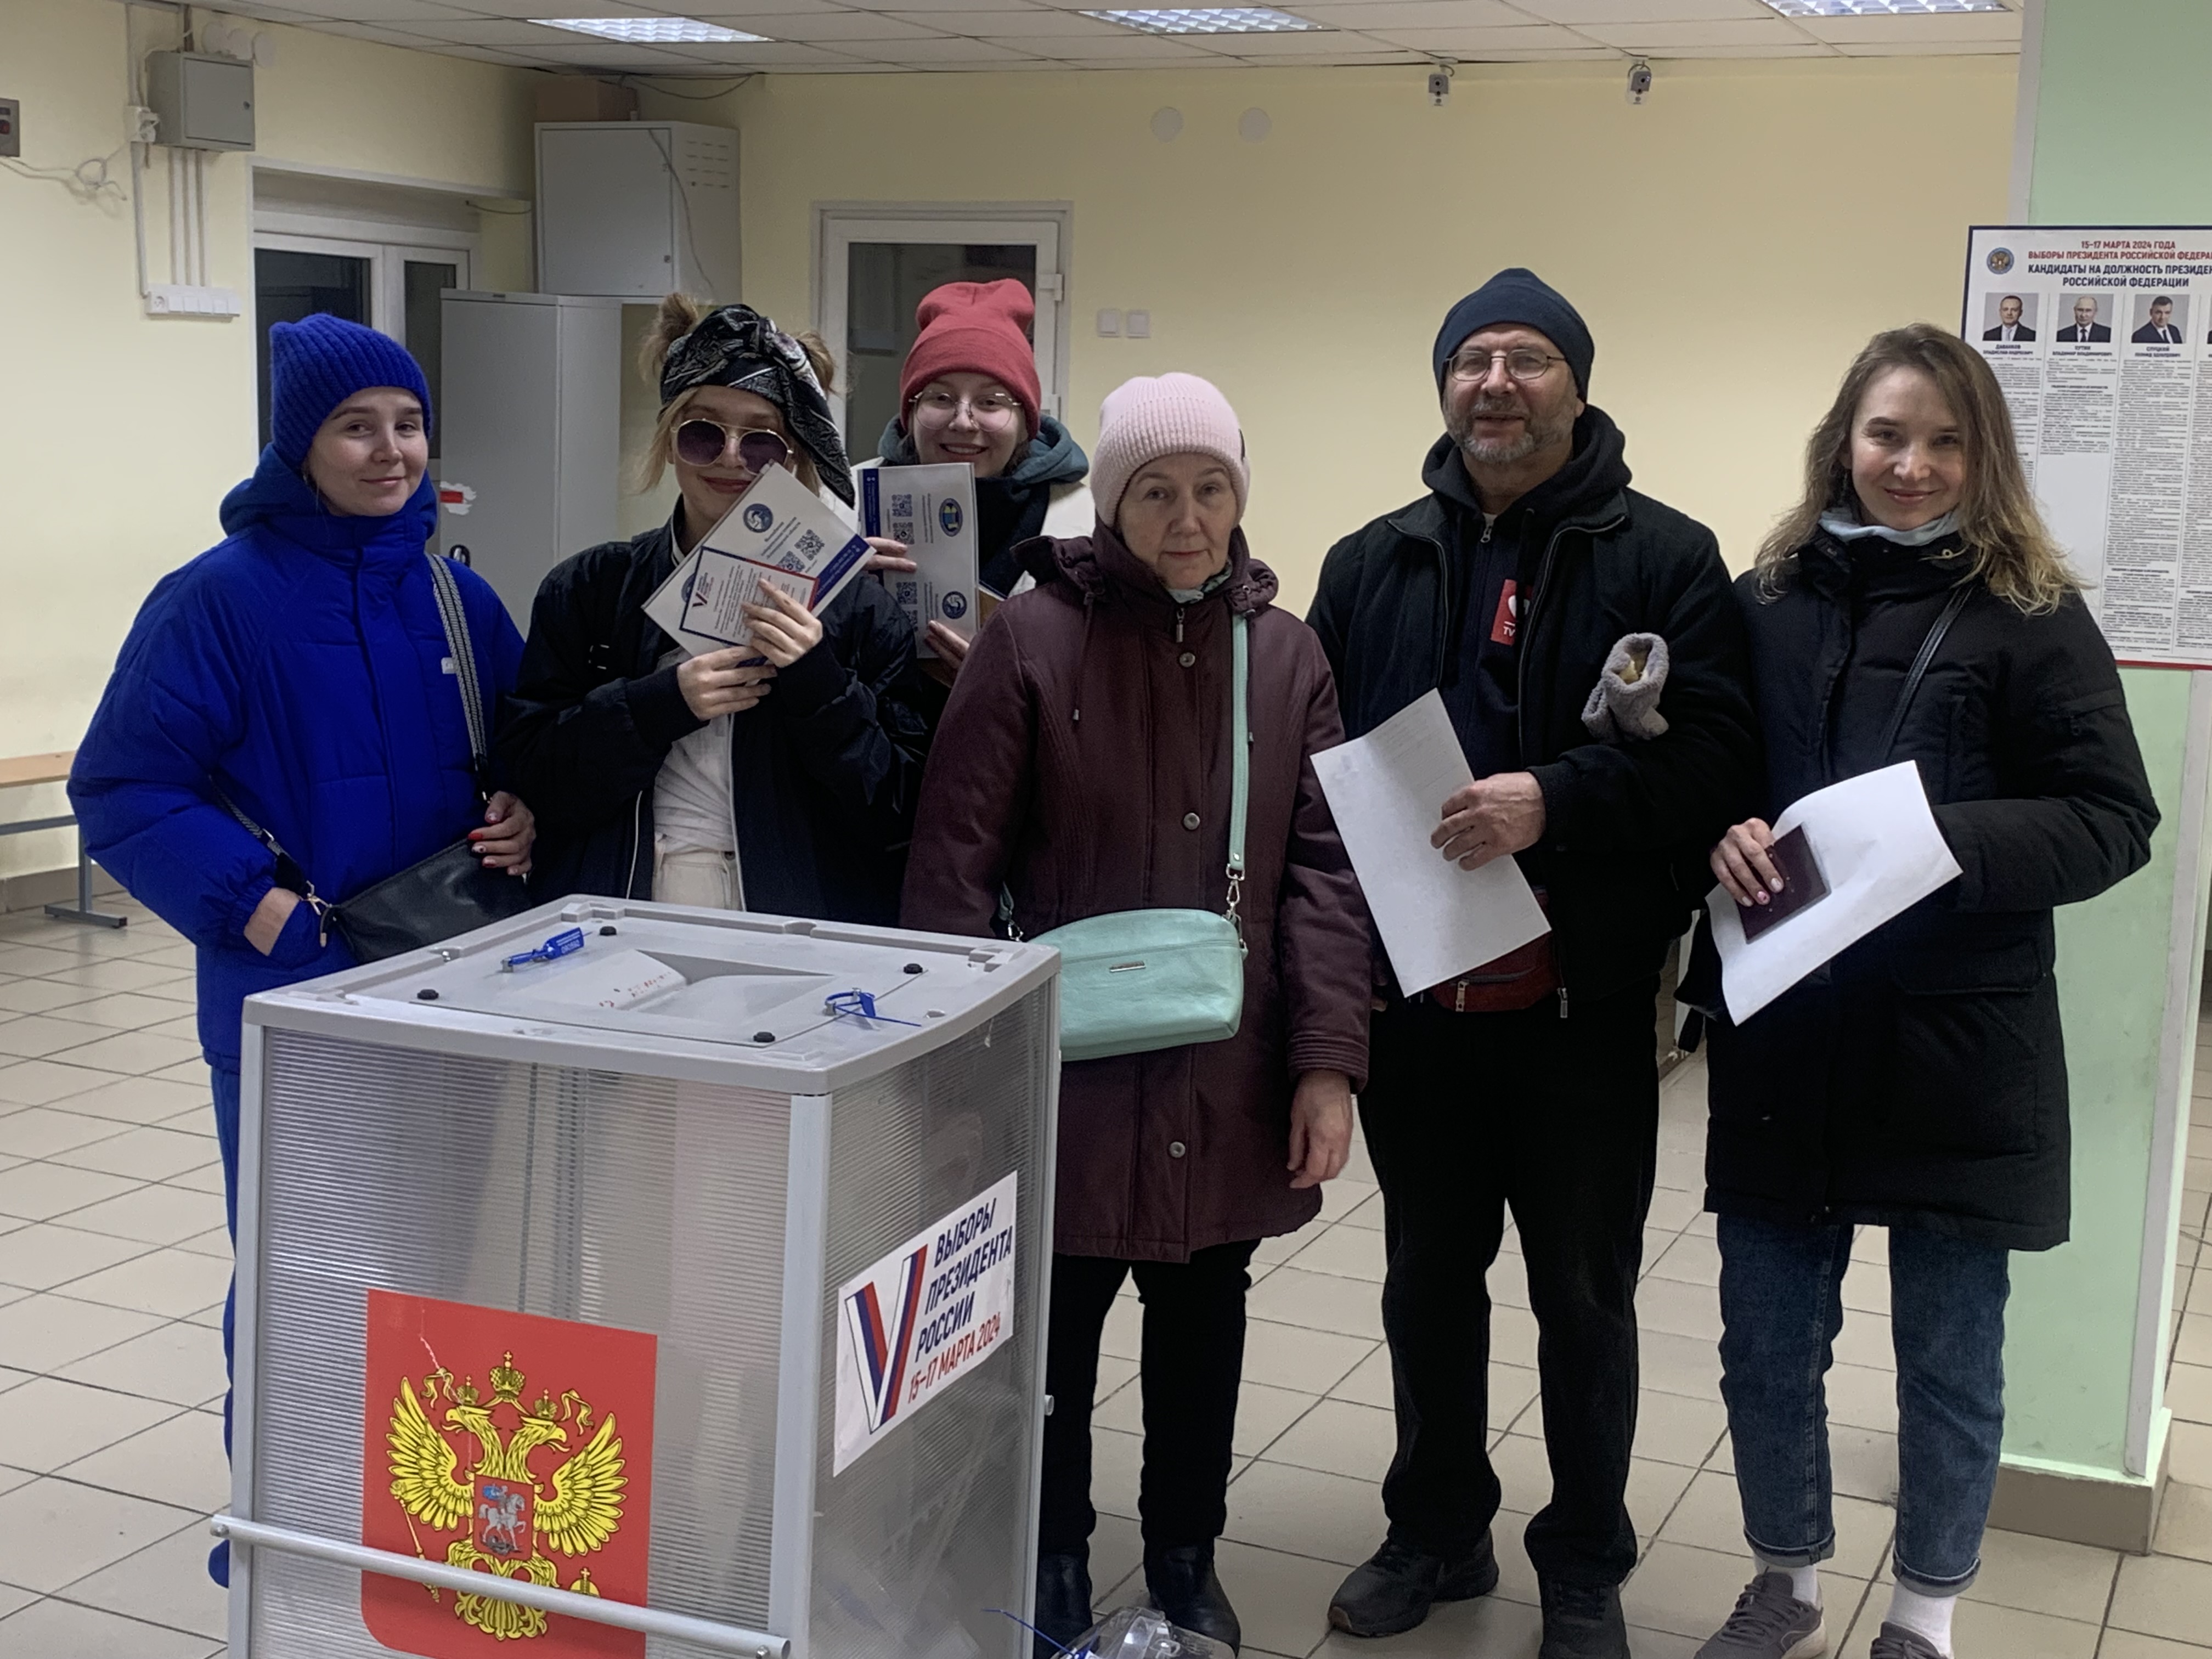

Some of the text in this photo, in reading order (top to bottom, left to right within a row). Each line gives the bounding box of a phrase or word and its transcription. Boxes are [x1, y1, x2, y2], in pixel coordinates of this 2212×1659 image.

[2028, 250, 2212, 261] ВЫБОРЫ ПРЕЗИДЕНТА РОССИЙСКОЙ ФЕДЕРА
[2154, 241, 2176, 250] ГОДА
[2028, 264, 2085, 275] КАНДИДАТЫ
[2089, 264, 2101, 274] НА
[2103, 264, 2163, 275] ДОЛЖНОСТЬ
[2063, 275, 2190, 288] РОССИЙСКОЙ ФЕДЕРАЦИИ
[934, 1198, 996, 1268] ВЫБОРЫ
[924, 1225, 1013, 1316] ПРЕЗИДЕНТА
[915, 1291, 975, 1363] РОССИИ
[938, 1330, 975, 1380] МАРТА
[976, 1311, 1001, 1352] 2024
